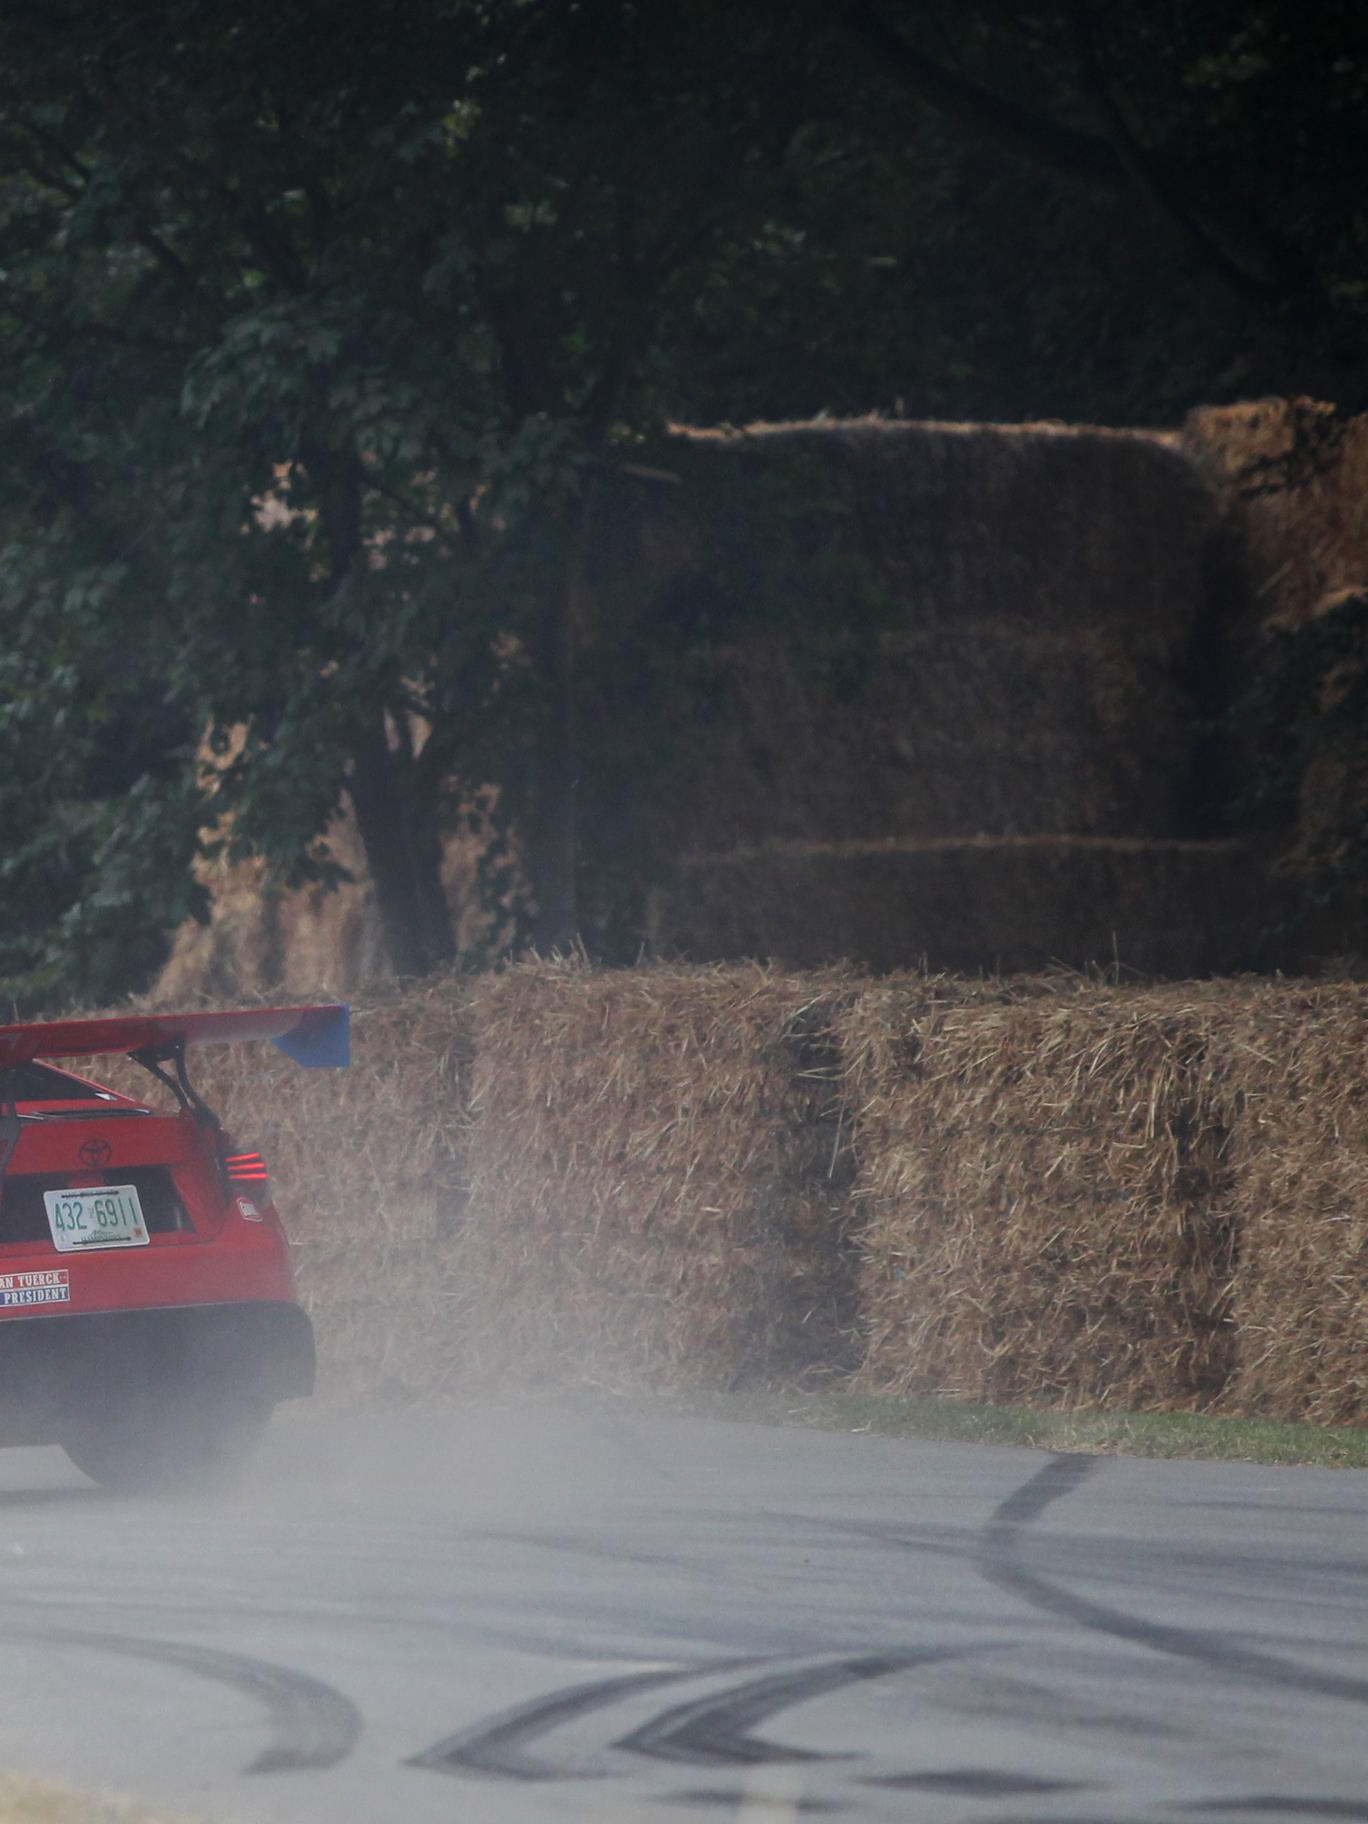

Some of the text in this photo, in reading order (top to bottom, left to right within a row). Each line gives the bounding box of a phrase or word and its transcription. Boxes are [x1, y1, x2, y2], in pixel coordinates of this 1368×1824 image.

[55, 1198, 138, 1231] 432 6911
[17, 1271, 60, 1288] TUERCK
[4, 1287, 67, 1305] PRESIDENT
